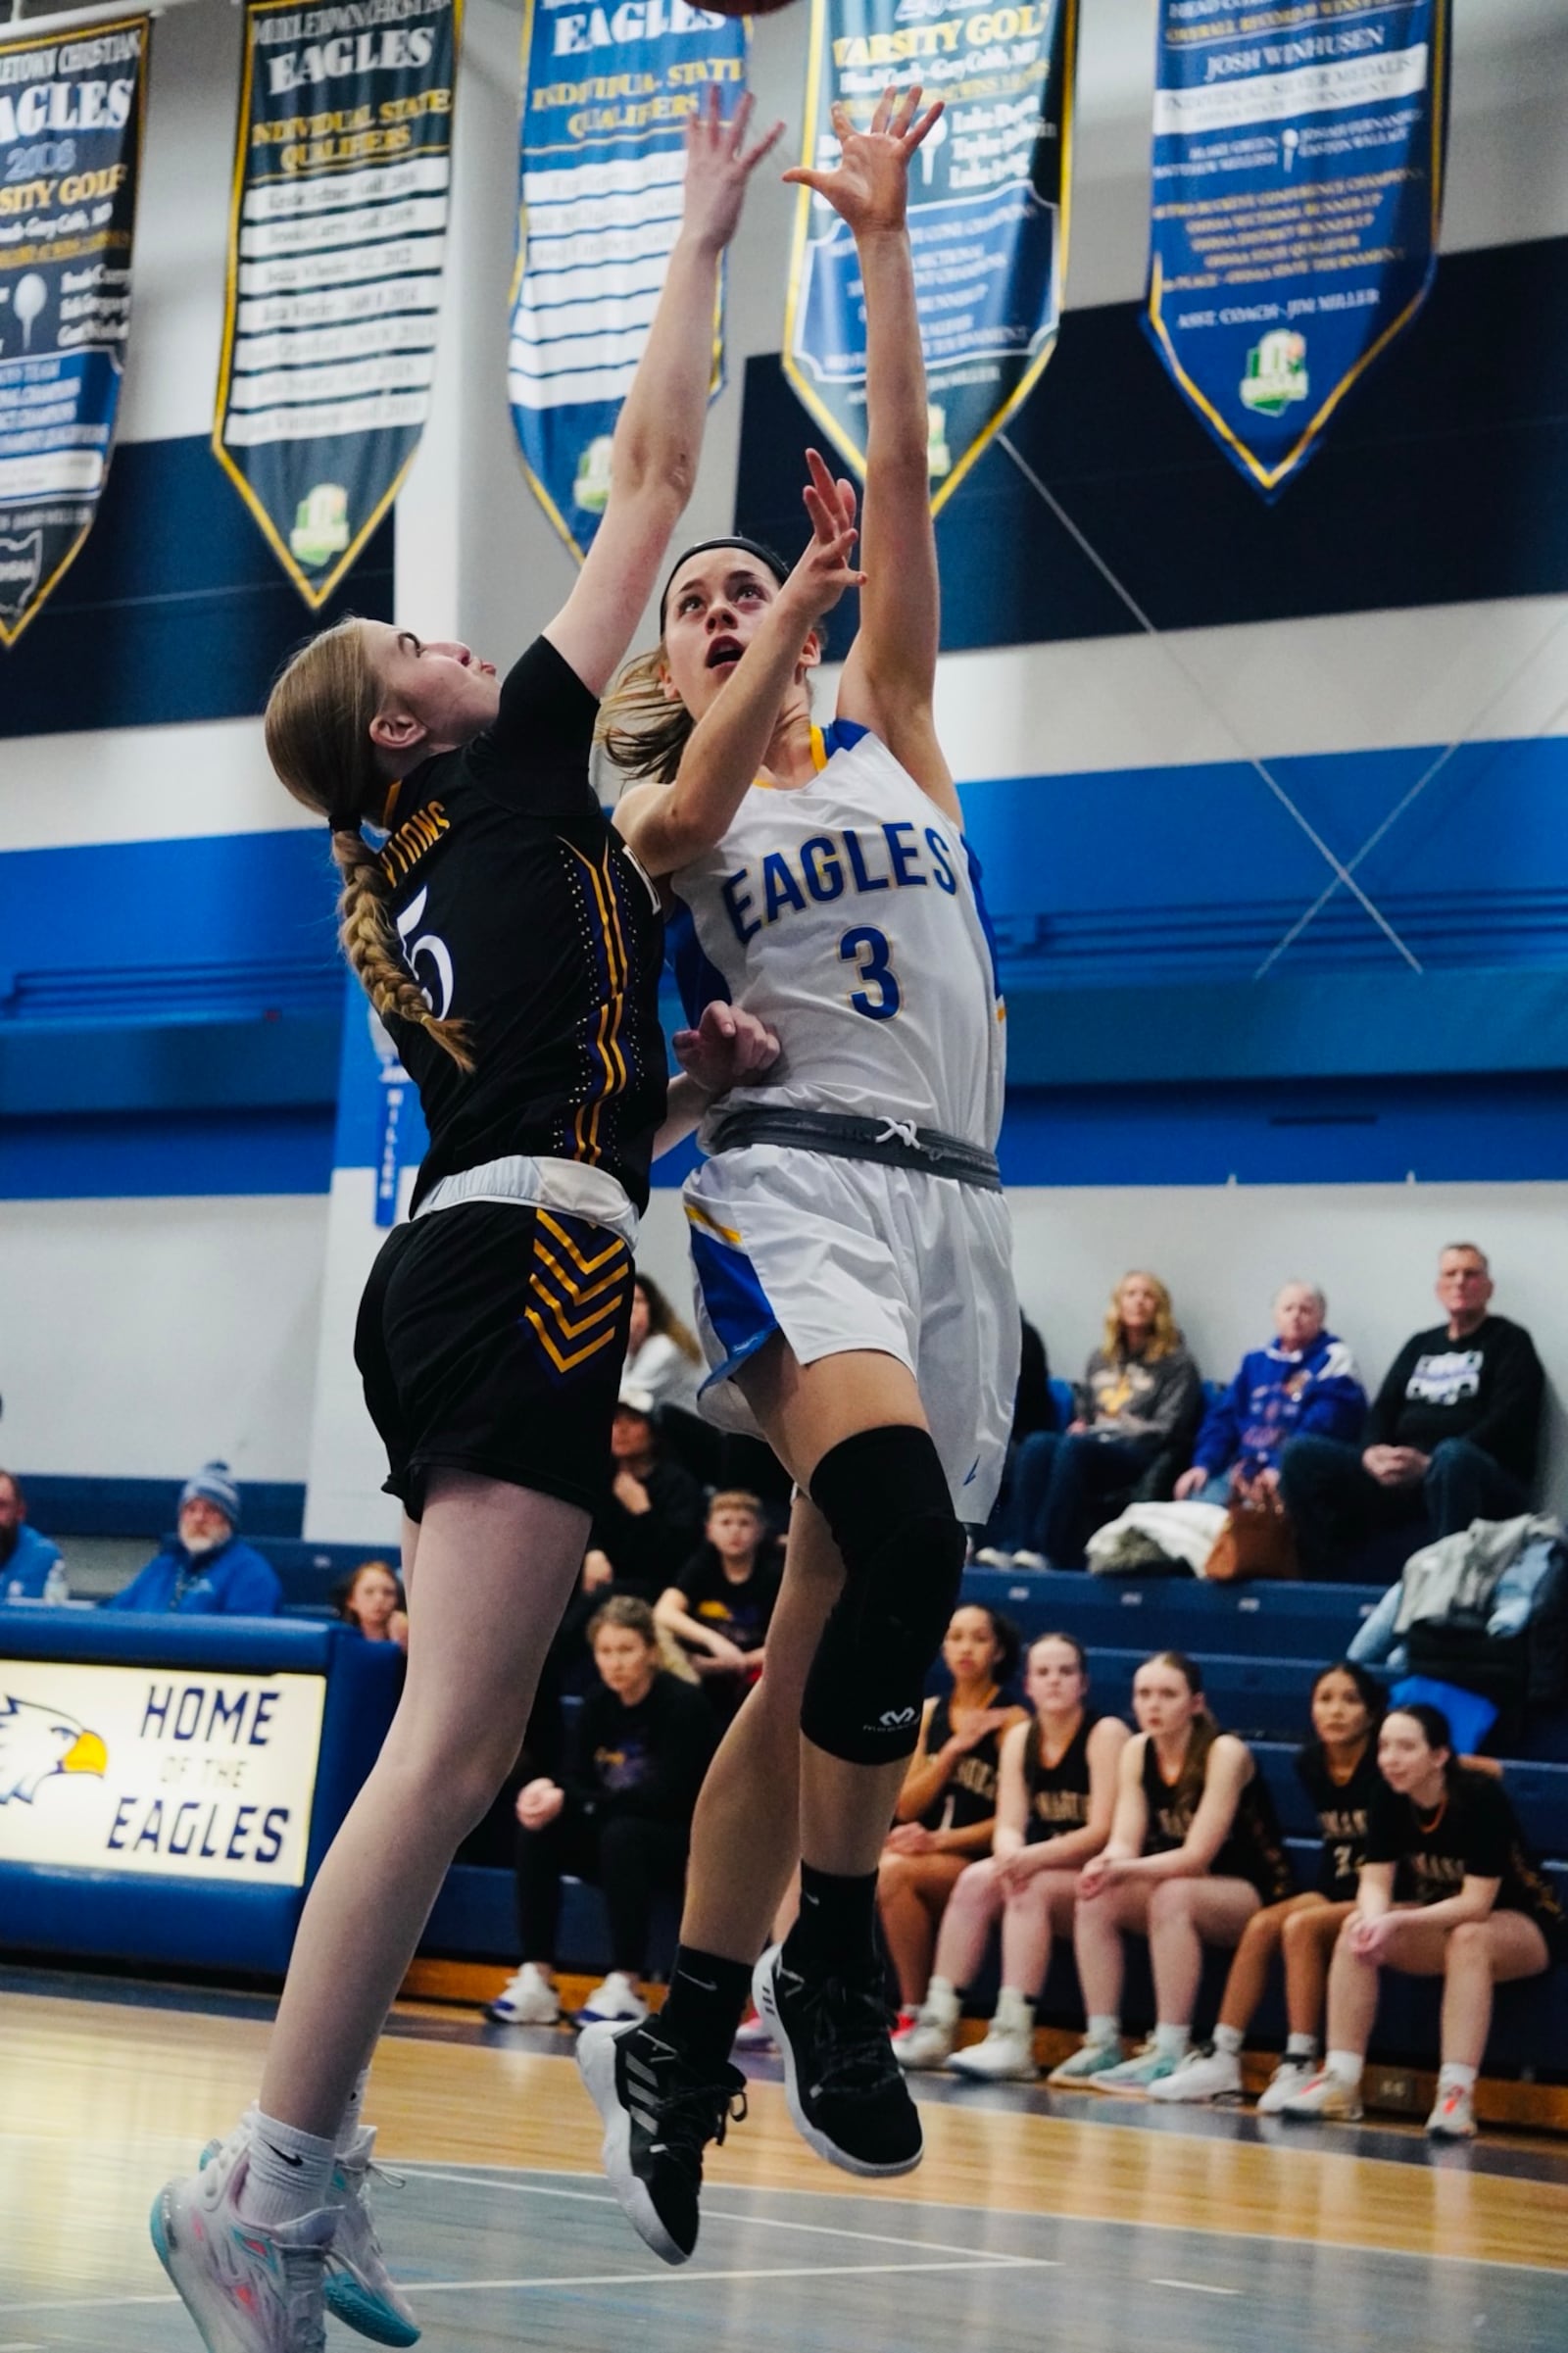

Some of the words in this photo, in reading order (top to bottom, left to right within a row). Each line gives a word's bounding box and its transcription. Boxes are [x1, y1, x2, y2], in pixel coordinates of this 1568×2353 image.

[267, 26, 434, 95] EAGLES
[833, 20, 963, 68] VARSITY
[1205, 49, 1260, 82] JOSH
[59, 164, 126, 198] GOLF
[721, 820, 958, 946] EAGLES
[396, 885, 455, 1022] 5
[836, 922, 906, 1024] 3
[139, 1685, 281, 1746] HOME
[106, 1796, 291, 1863] EAGLES
